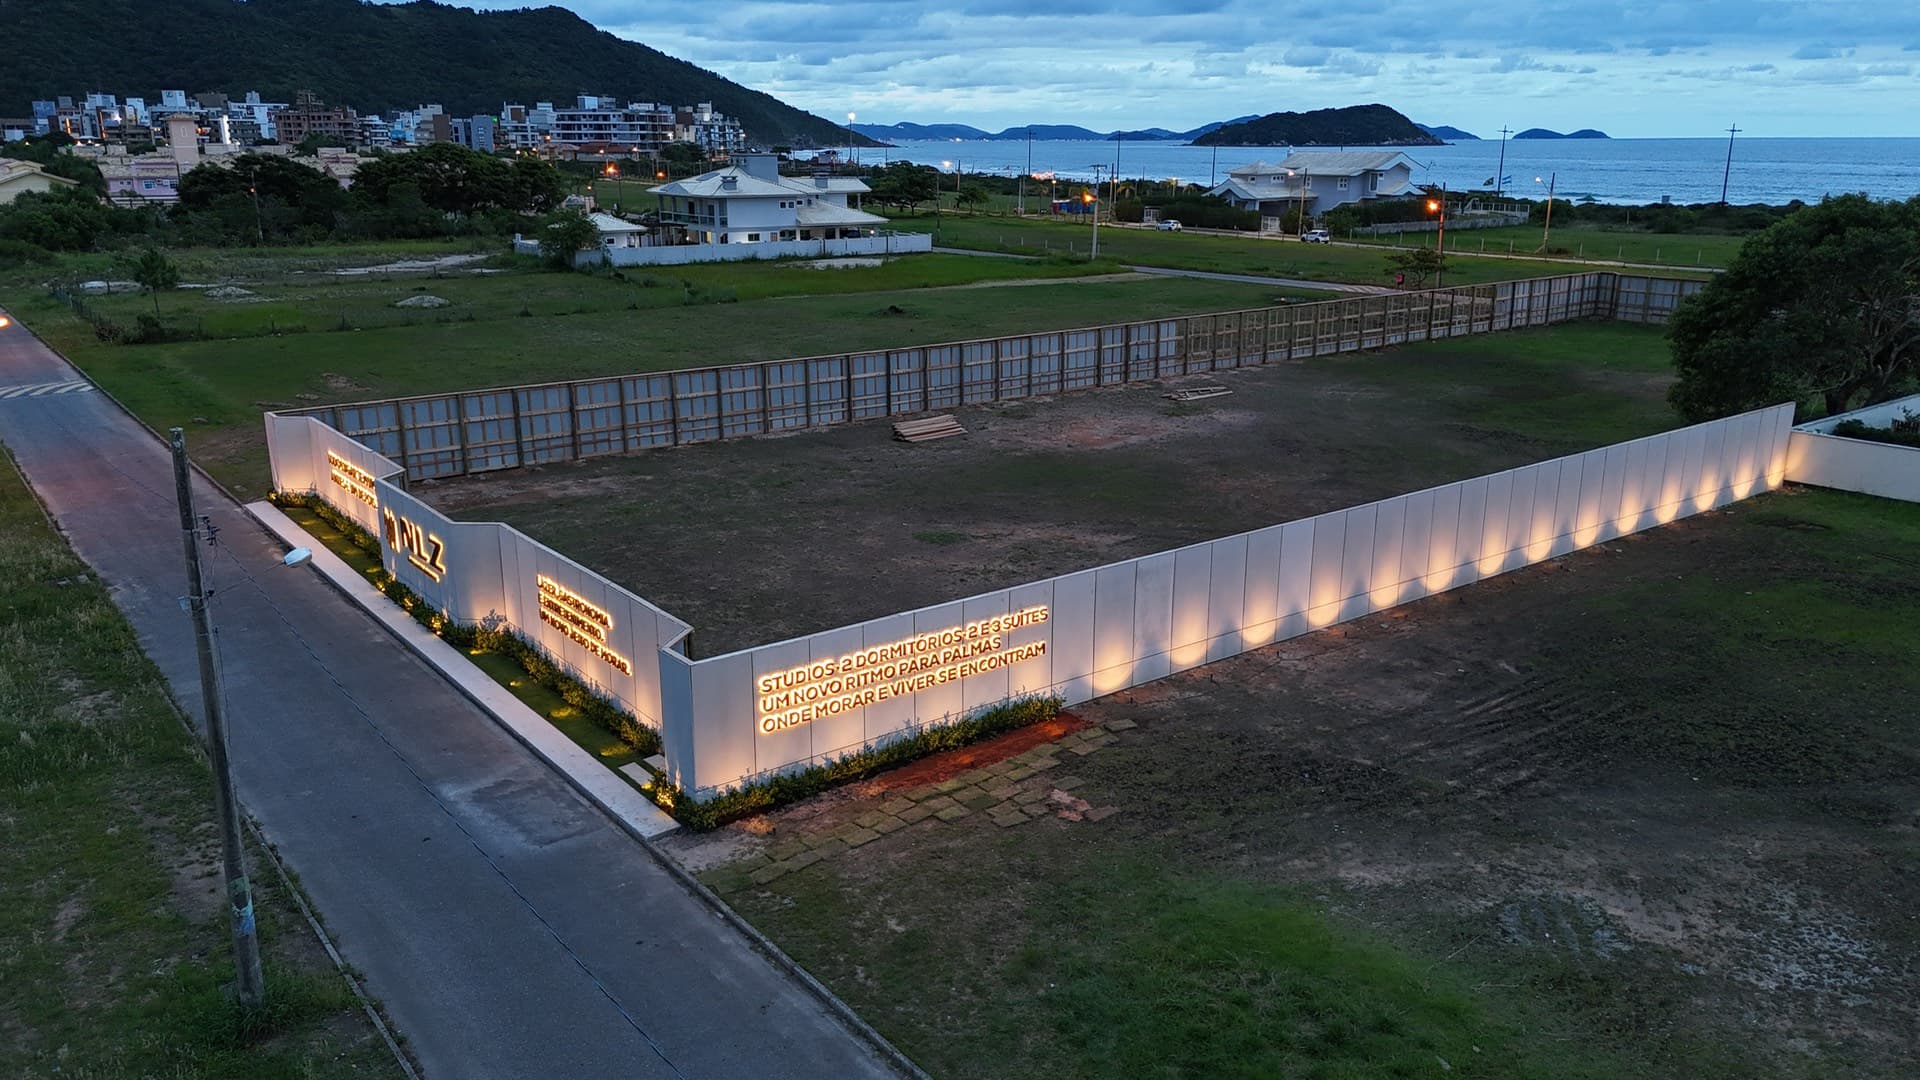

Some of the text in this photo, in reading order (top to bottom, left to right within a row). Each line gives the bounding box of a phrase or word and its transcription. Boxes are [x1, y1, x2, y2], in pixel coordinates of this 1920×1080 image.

[400, 515, 446, 575] NLZ
[762, 608, 1049, 692] STUDIOS 2 DORMITÓRIOS 2 E 3 SUÍTES
[763, 636, 1001, 712] UM NOVO RITMO PARA PALMAS
[763, 642, 1046, 732] ONDE MORAR E VIVER SE ENCONTRAM
